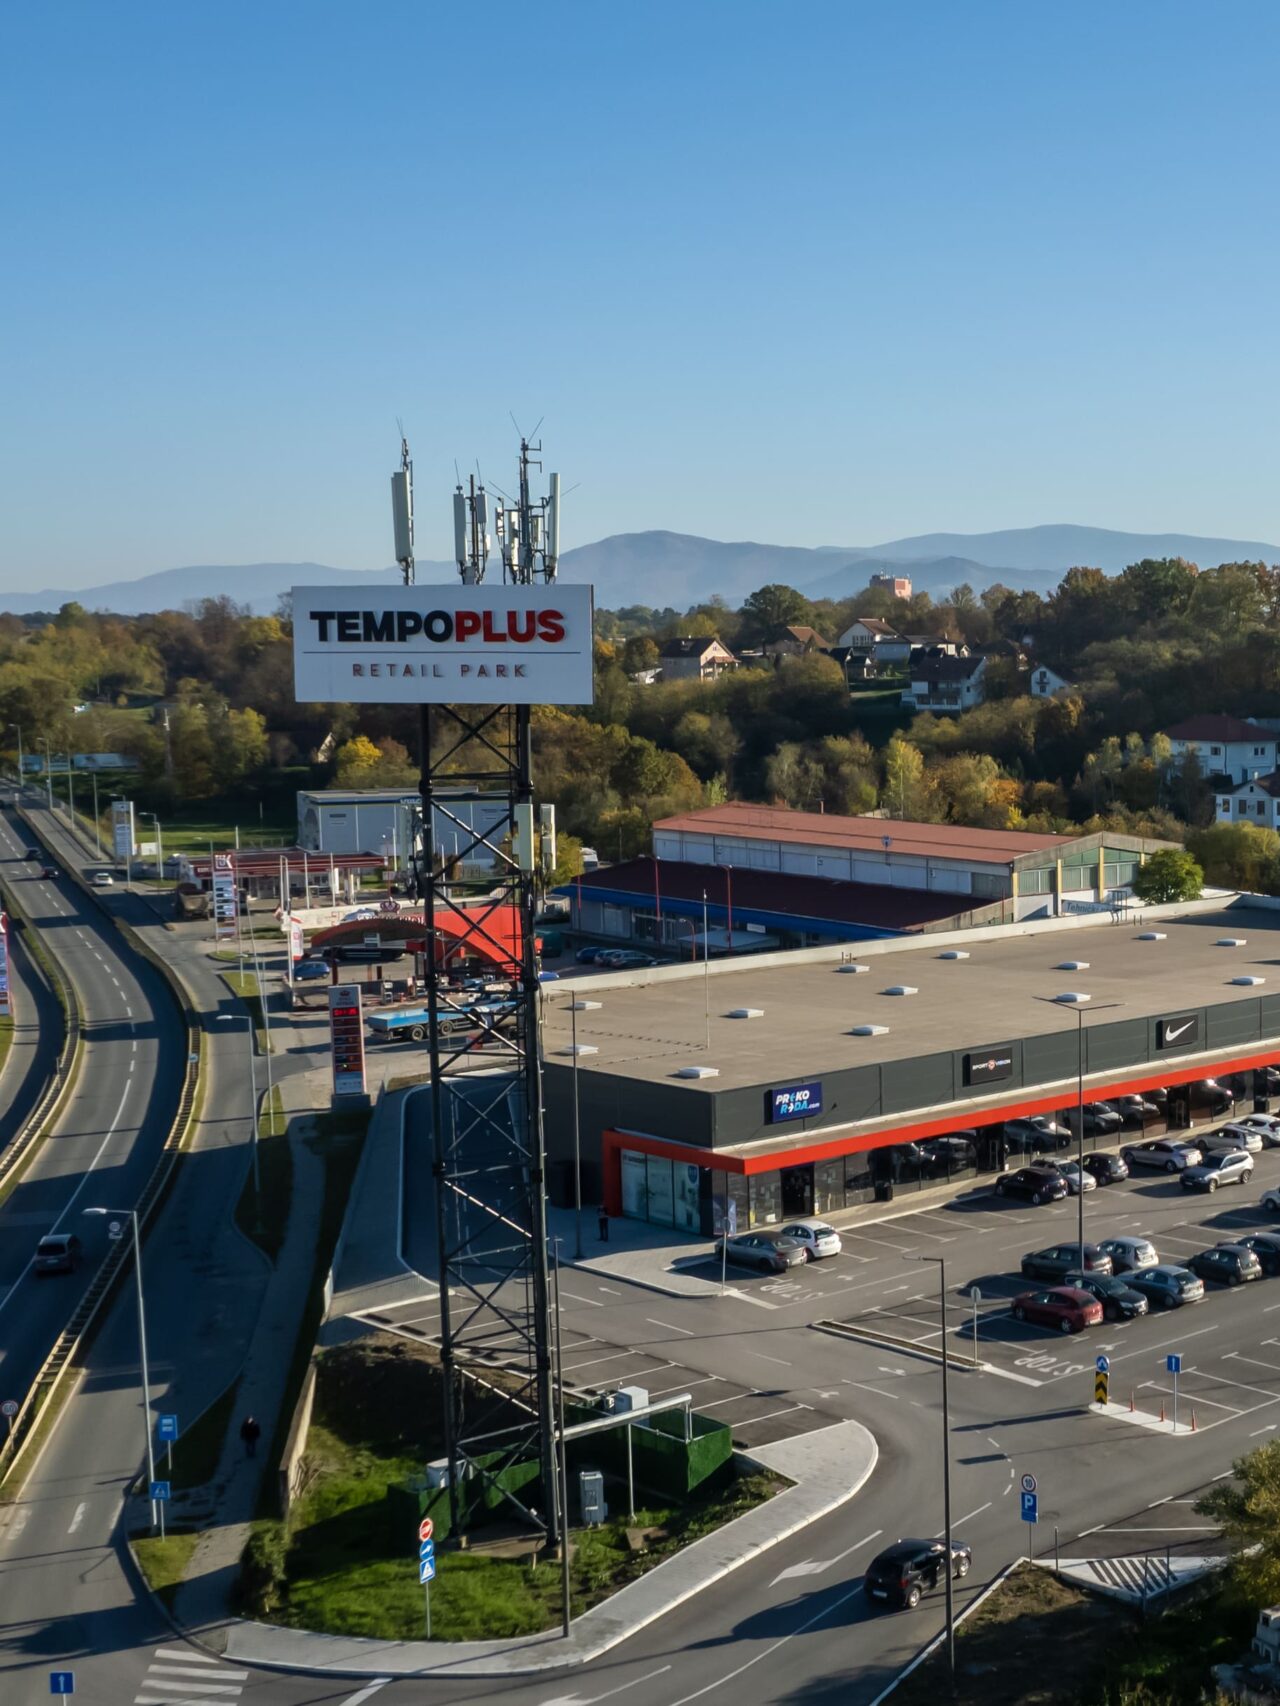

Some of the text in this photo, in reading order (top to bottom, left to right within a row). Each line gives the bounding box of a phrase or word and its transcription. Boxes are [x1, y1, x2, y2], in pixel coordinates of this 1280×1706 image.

[310, 609, 565, 642] TEMPOPLUS
[352, 663, 526, 678] RETAIL PARK
[1013, 1355, 1084, 1376] STOP
[1024, 1494, 1034, 1509] P
